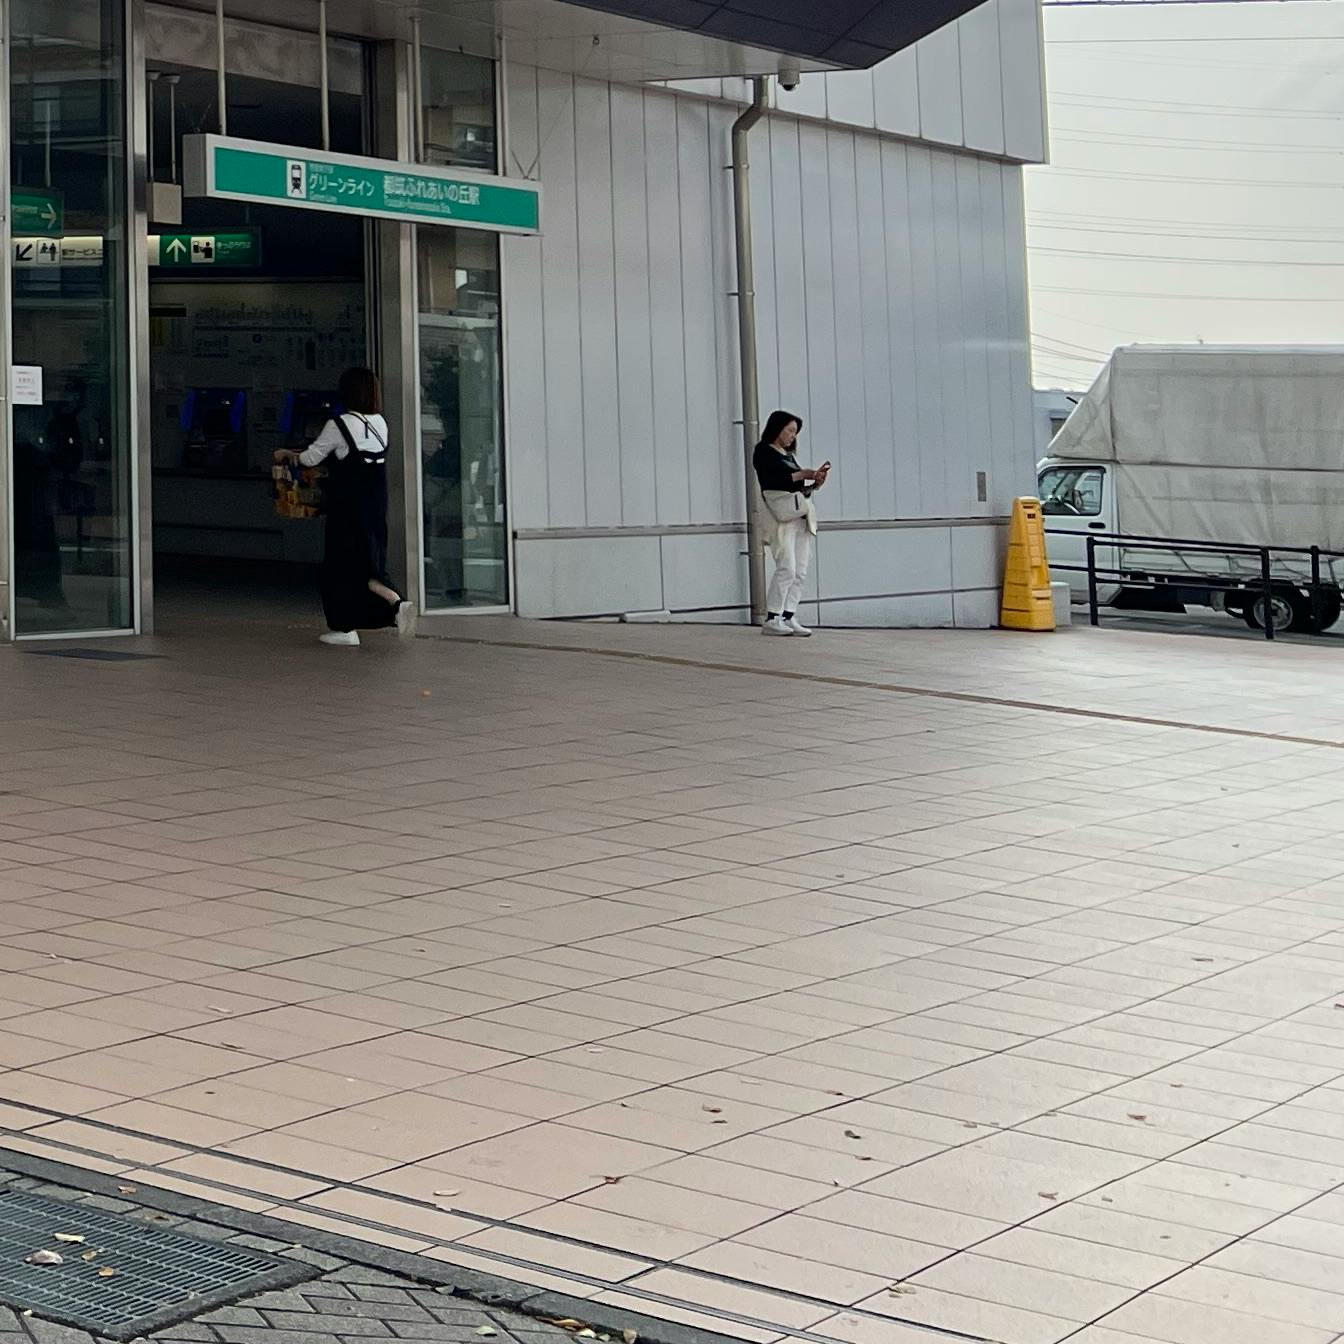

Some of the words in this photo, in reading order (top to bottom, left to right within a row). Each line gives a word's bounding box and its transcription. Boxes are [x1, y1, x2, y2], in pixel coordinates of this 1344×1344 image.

[309, 172, 375, 196] グリーンライン
[384, 175, 480, 205] 都筑ふれあいの丘駅
